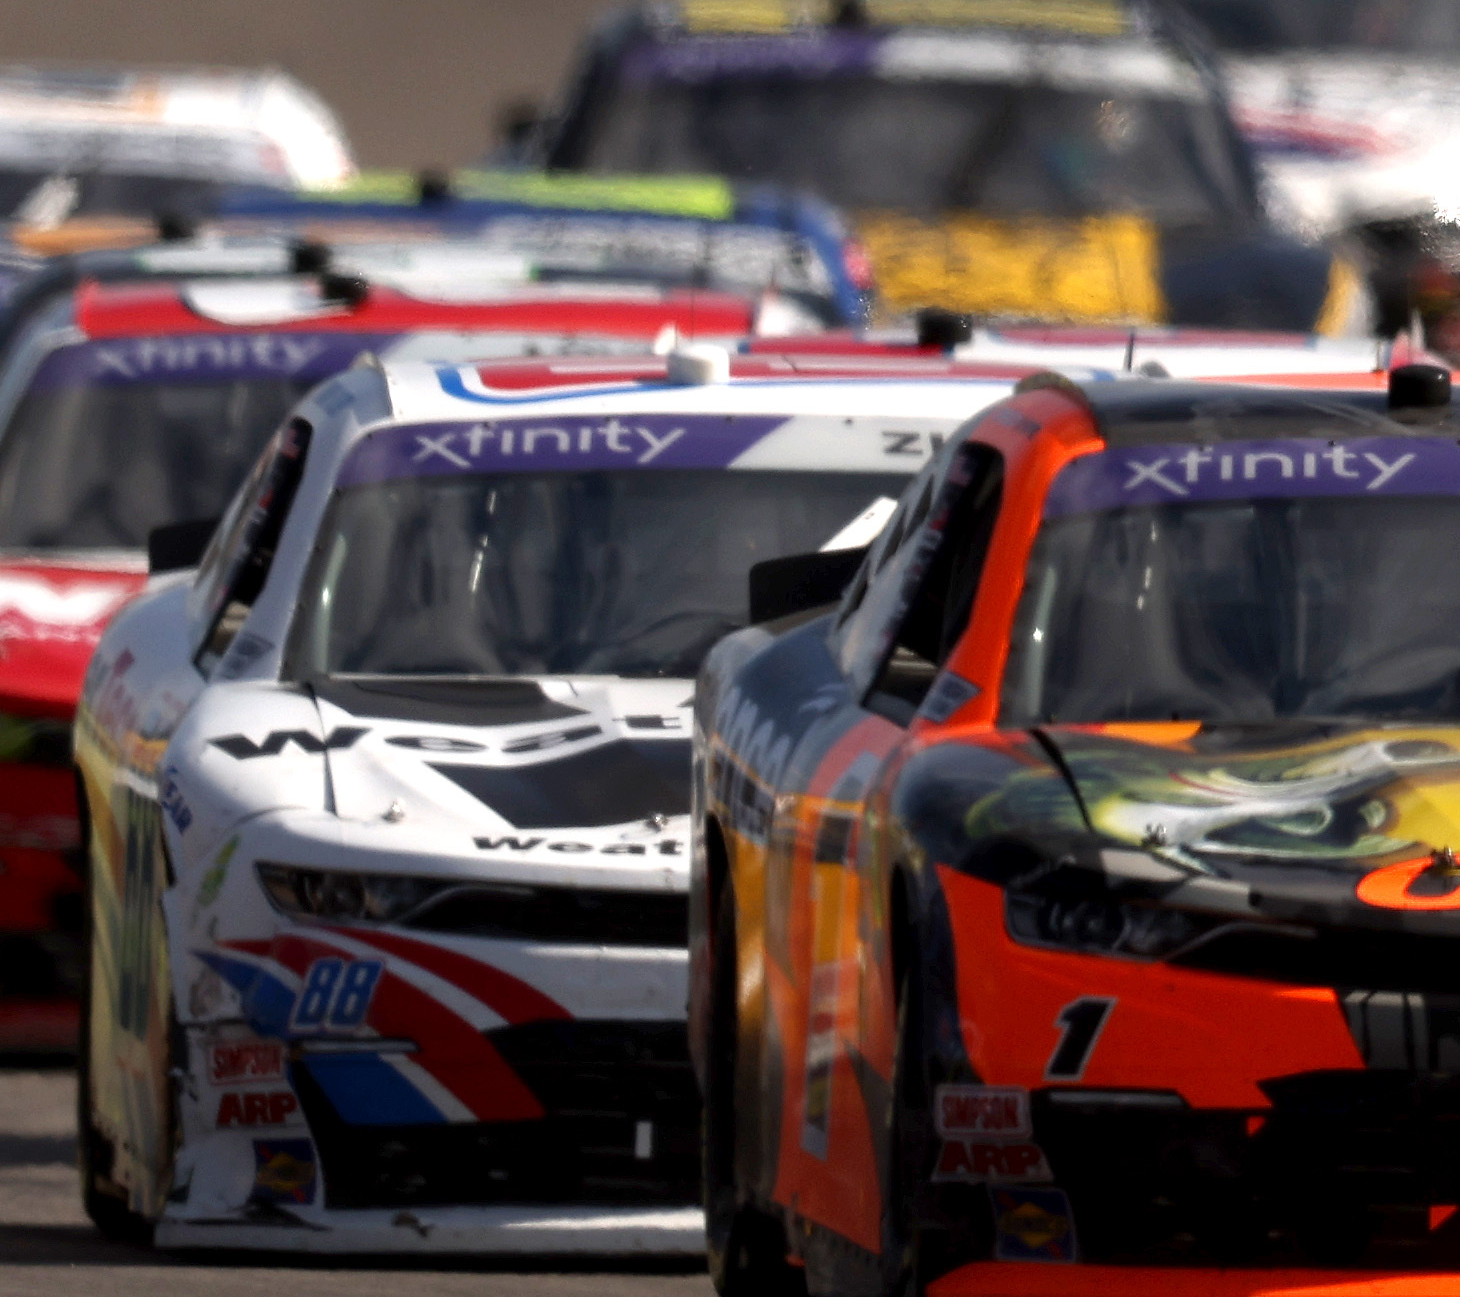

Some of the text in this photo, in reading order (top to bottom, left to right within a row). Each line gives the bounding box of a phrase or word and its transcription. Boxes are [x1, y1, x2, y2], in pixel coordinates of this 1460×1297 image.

[412, 421, 686, 469] xfinity
[1123, 444, 1416, 496] xfinity
[289, 957, 385, 1033] 88
[1043, 995, 1118, 1082] 1
[216, 1091, 298, 1127] ARP
[938, 1141, 1041, 1175] ARP
